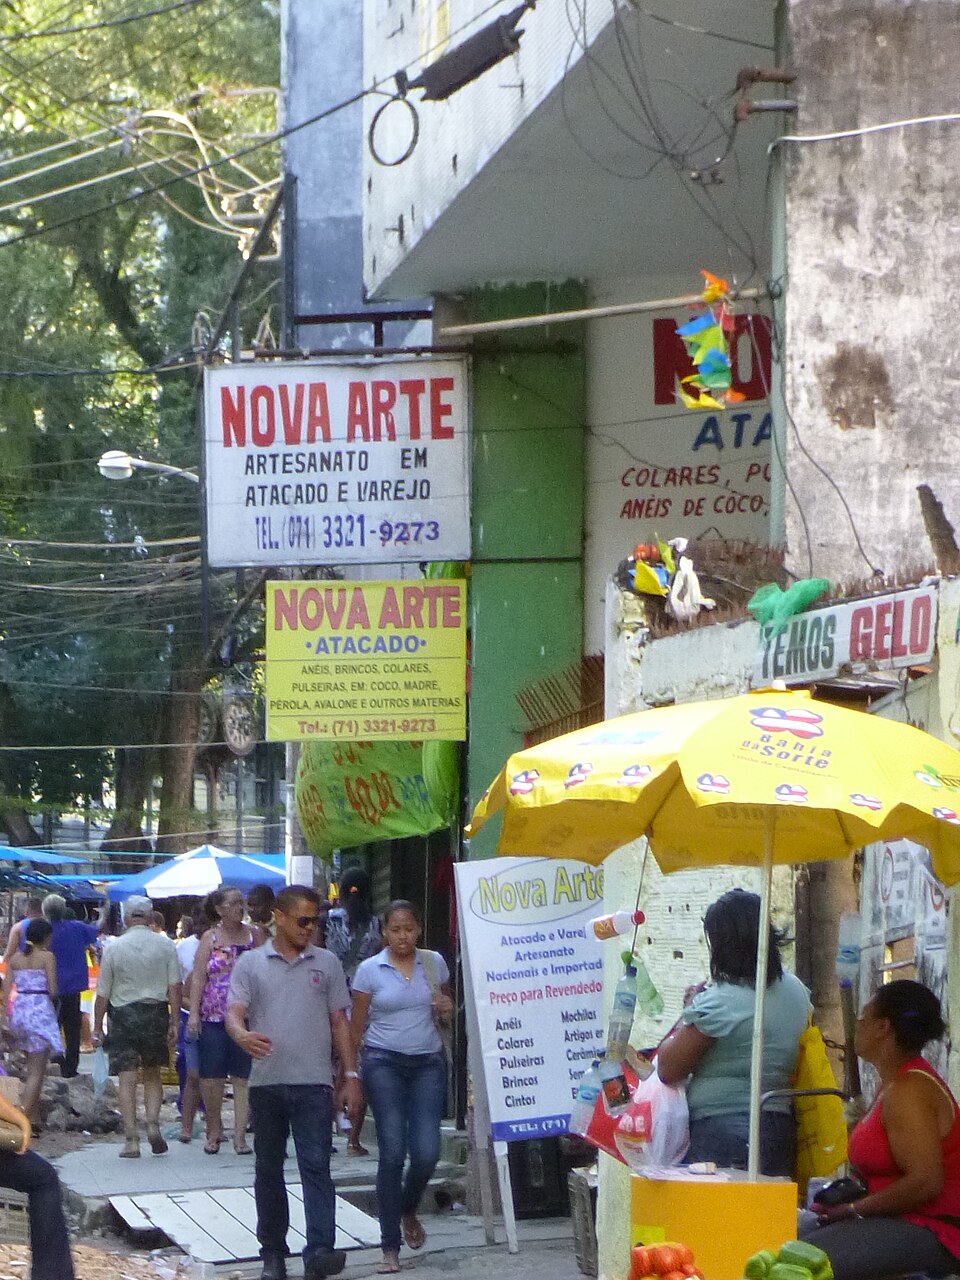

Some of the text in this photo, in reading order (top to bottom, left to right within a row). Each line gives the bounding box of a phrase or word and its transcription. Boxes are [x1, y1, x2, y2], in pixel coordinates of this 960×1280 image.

[220, 377, 455, 447] NOVA ARTE
[245, 448, 428, 475] ARTESANATO EM
[246, 479, 431, 507] ATACADO E VAREJO
[683, 497, 705, 516] DE
[255, 514, 440, 550] TEL. (071) 3321-9273
[274, 586, 462, 631] NOVA ARTE
[760, 594, 932, 679] TEMOS GELO
[314, 699, 358, 710] AVALONE
[361, 699, 368, 709] E
[370, 698, 411, 709] OUTROS
[332, 719, 359, 737] (71)
[363, 719, 436, 734] 3321-9273
[759, 733, 833, 758] Bahia
[760, 745, 830, 769] Sorte
[478, 875, 548, 915] Nova
[500, 930, 547, 947] Atacado
[549, 932, 555, 942] e
[514, 946, 576, 963] Artesanato
[486, 966, 540, 983] Nacionais
[542, 967, 549, 977] e
[490, 988, 519, 1008] Preço
[520, 986, 544, 1005] para
[495, 1017, 523, 1032] Anéis
[561, 1008, 597, 1024] Mochilas
[497, 1036, 535, 1051] Colares
[564, 1028, 594, 1044] Artigos
[500, 1054, 545, 1071] Pulseiras
[502, 1074, 539, 1090] Brincos
[504, 1095, 536, 1109] Cintos
[509, 1117, 568, 1134] TEL: (71)
